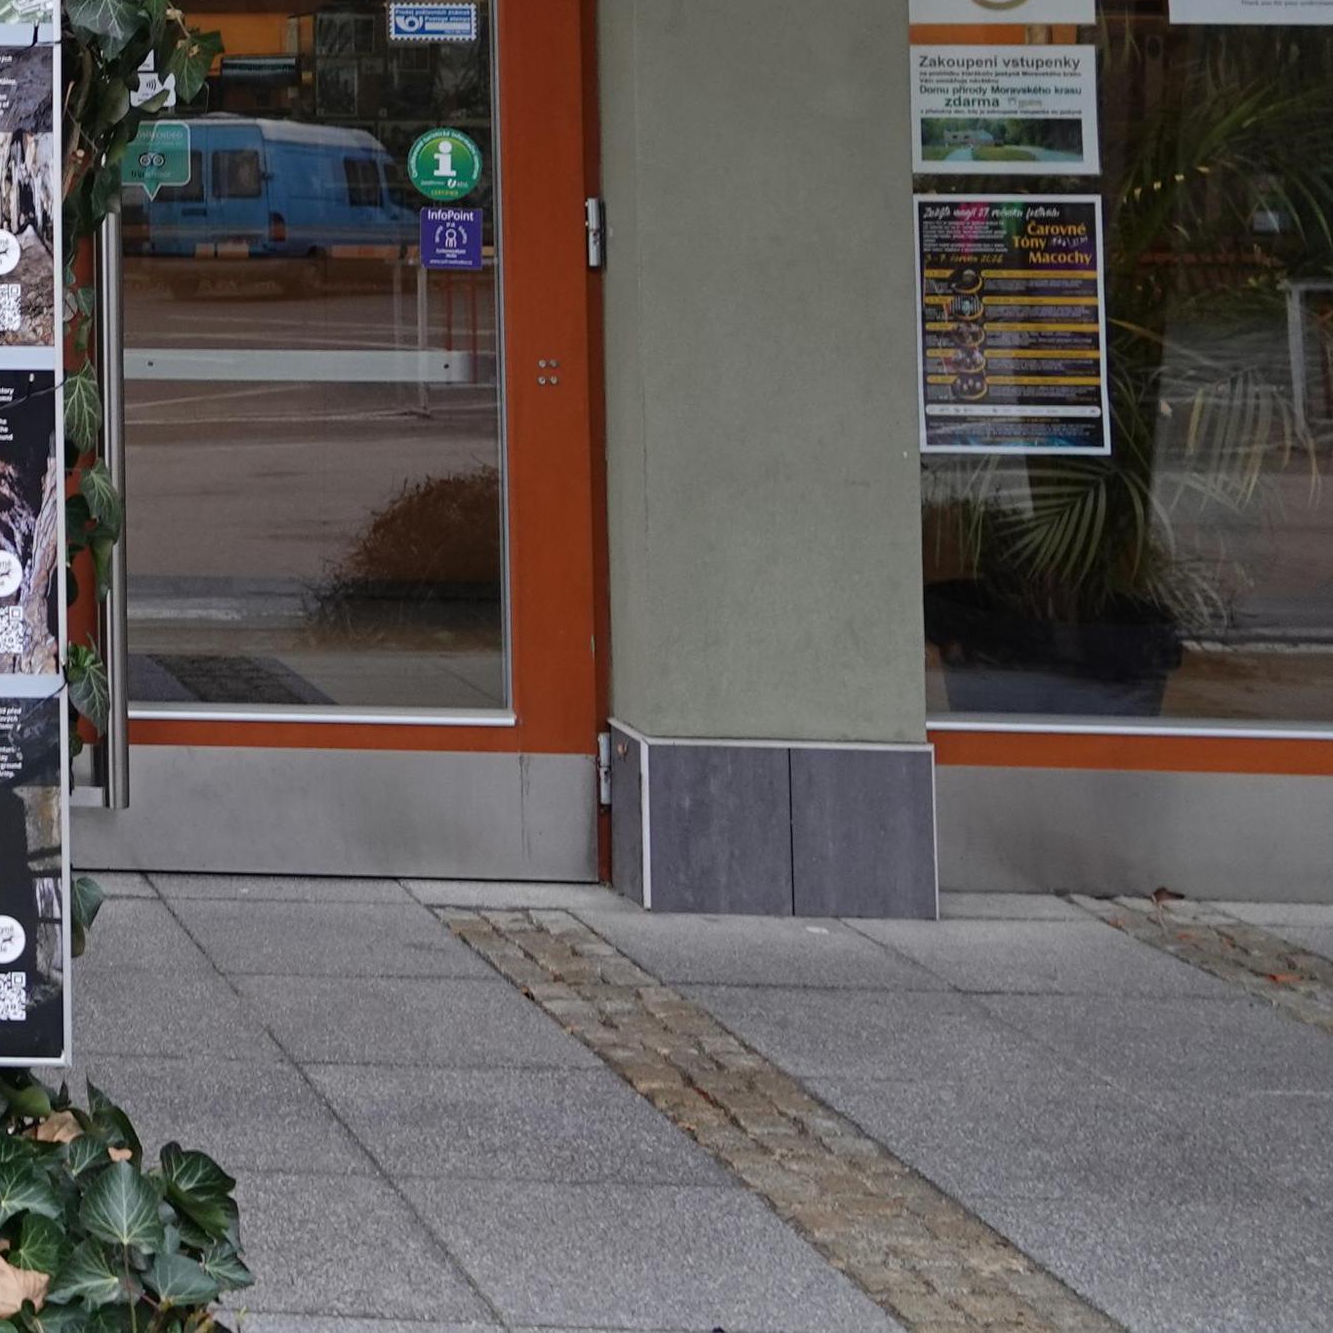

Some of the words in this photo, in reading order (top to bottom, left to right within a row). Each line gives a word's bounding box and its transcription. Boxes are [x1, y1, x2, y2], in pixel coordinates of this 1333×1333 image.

[919, 55, 998, 70] Zakoupení
[1003, 56, 1080, 70] vstupenky
[920, 85, 949, 95] Domu
[952, 85, 988, 96] přírody
[991, 84, 1051, 95] Moravského
[1055, 85, 1082, 94] krasu
[945, 96, 1000, 108] zdarma
[428, 209, 474, 222] InfoPoint
[1027, 220, 1086, 234] Čarovné
[1013, 236, 1047, 249] Tóny
[1029, 251, 1092, 266] Macochy
